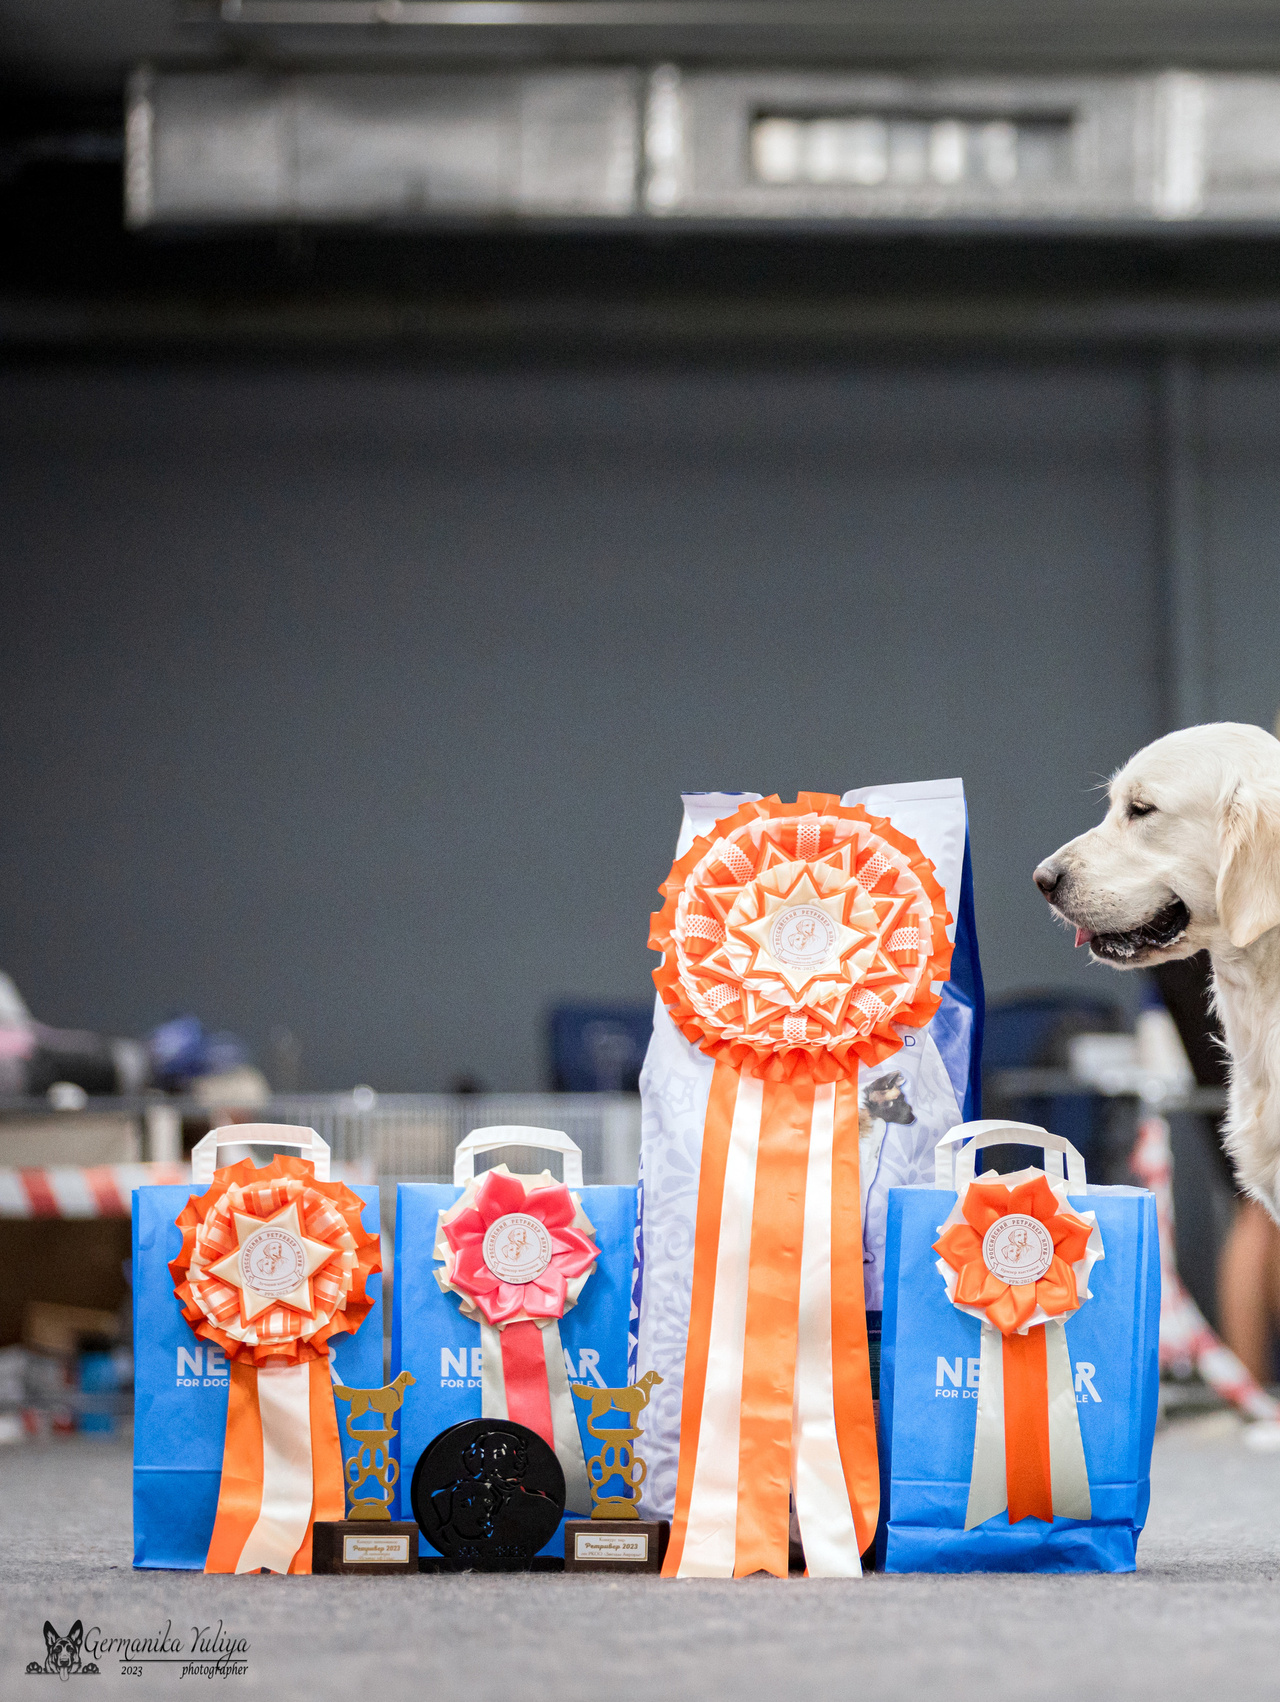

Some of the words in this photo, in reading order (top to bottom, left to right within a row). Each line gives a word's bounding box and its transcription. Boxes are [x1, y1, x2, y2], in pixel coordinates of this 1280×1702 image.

[988, 1222, 1008, 1260] РОССИЙСКИЙ
[1012, 1220, 1042, 1235] РЕТРИВЕР
[176, 1378, 200, 1387] FOR
[203, 1378, 230, 1387] DOG
[440, 1380, 464, 1388] FOR
[935, 1389, 958, 1398] FOR
[584, 1542, 620, 1551] Ретривер
